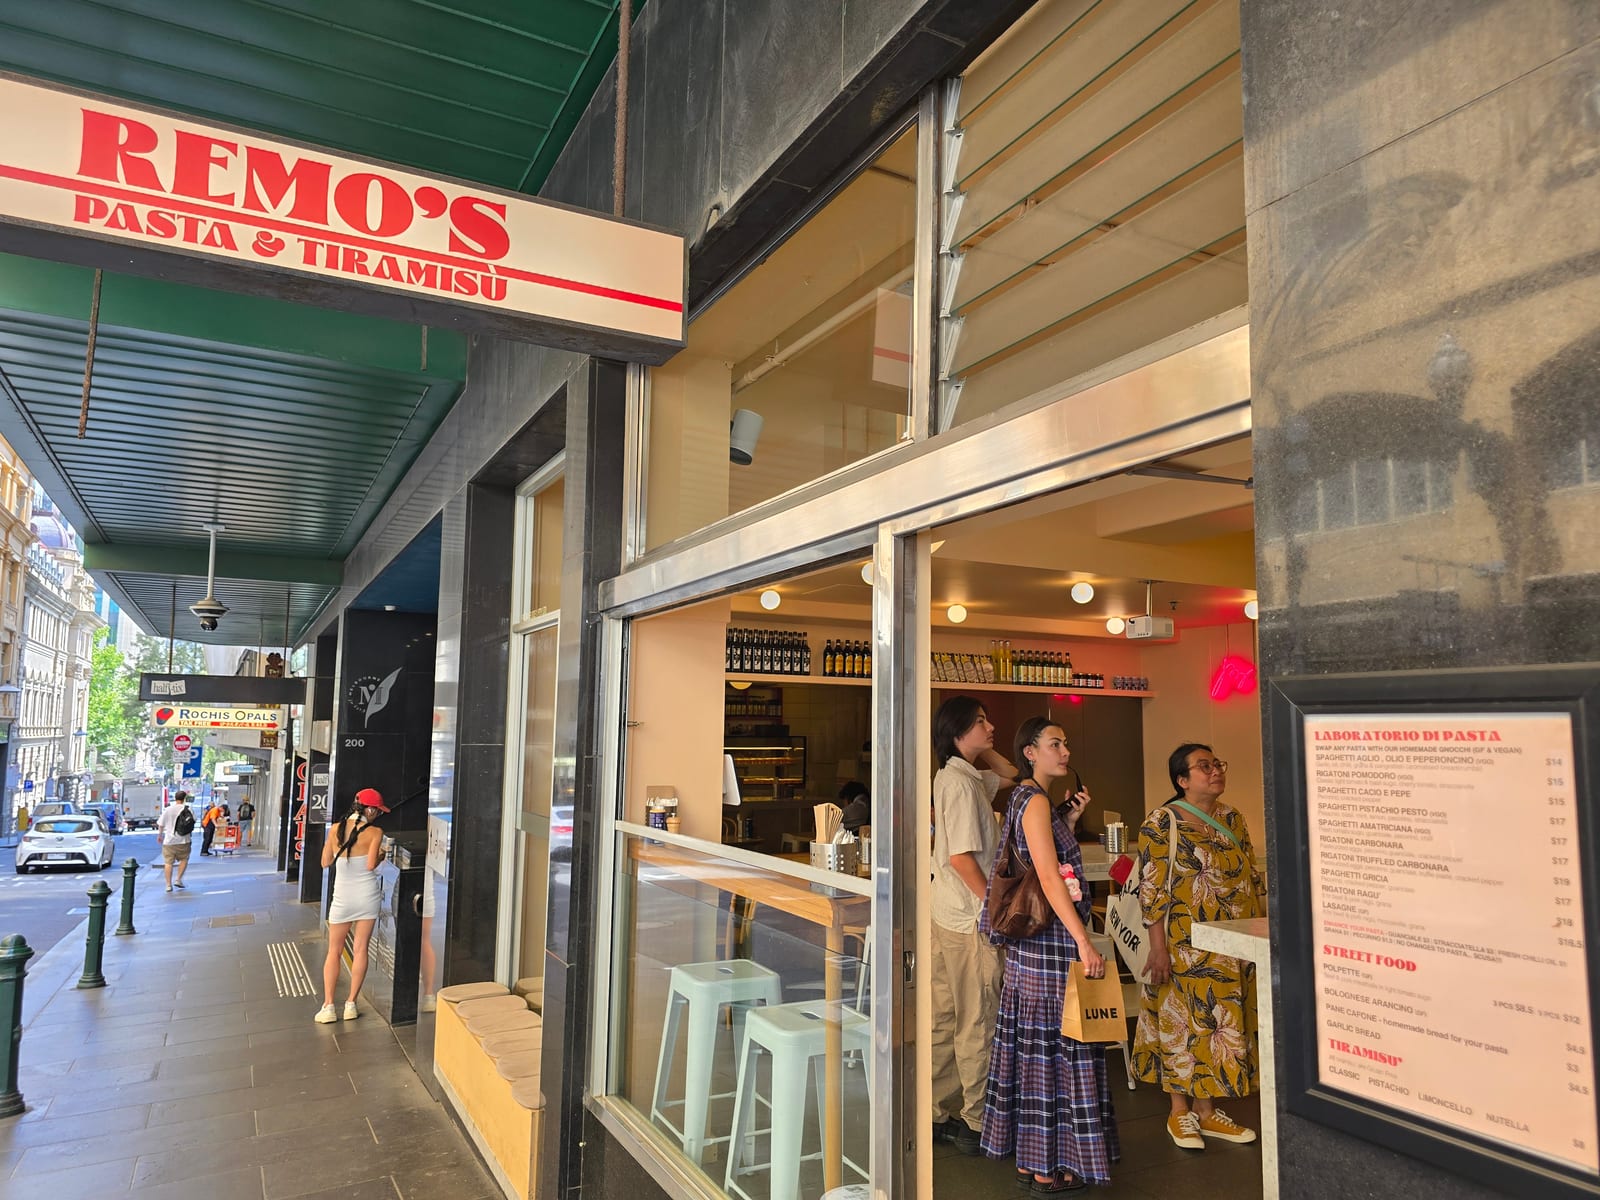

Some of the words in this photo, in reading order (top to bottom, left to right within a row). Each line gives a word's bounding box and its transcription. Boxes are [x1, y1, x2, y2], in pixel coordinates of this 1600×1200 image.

[77, 108, 510, 260] REMO'S
[73, 195, 240, 252] PASTA
[252, 231, 285, 257] &
[297, 238, 508, 302] TIRAMISÙ
[180, 709, 230, 720] ROCHIS
[235, 710, 277, 721] OPALS
[345, 739, 365, 747] 200
[1314, 731, 1420, 741] LABORATORIO
[1423, 731, 1440, 741] DI
[1443, 731, 1502, 742] PASTA
[1413, 756, 1474, 764] PEPERONCINO
[1546, 758, 1563, 766] $14
[1316, 770, 1350, 778] RIGATONI
[1352, 771, 1396, 780] POMODORO
[1547, 777, 1565, 786] $15
[1317, 786, 1357, 795] SPAGHETTI
[1358, 788, 1382, 796] CACIO
[1391, 790, 1412, 798] PEPE
[1318, 802, 1358, 812] SPAGHETTI
[1359, 805, 1400, 815] PISTACHIO
[1401, 808, 1429, 816] PESTO
[1549, 817, 1567, 826] $17
[1319, 819, 1358, 829] SPAGHETTI
[1360, 822, 1413, 833] AMATRICIANA
[1550, 837, 1568, 846] $17
[1320, 835, 1354, 845] RIGATONI
[1355, 838, 1404, 850] CARBONARA
[1552, 856, 1569, 866] $17
[1320, 851, 1355, 862] RIGATONI
[1357, 855, 1395, 866] TRUFFLED
[1396, 860, 1450, 873] CARBONARA
[1321, 868, 1361, 879] SPAGHETTI
[1362, 873, 1389, 883] GRICIA
[1554, 897, 1572, 906] $17
[1322, 885, 1356, 896] RIGATONI
[1323, 901, 1357, 913] LASAGNE
[1407, 941, 1436, 952] CHANGES
[1323, 944, 1374, 964] STREET
[1376, 954, 1417, 972] FOOD
[1324, 963, 1360, 977] POLPETTE
[1325, 987, 1370, 1004] BOLOGNESE
[1372, 998, 1414, 1014] ARANCINO
[1085, 1008, 1118, 1020] LUNE
[1326, 1003, 1345, 1015] PANE
[1346, 1008, 1377, 1023] CAFONE
[1383, 1017, 1425, 1034] homemade
[1426, 1027, 1449, 1040] bread
[1451, 1034, 1462, 1043] for
[1464, 1038, 1483, 1051] your
[1485, 1043, 1509, 1057] pasta
[1327, 1019, 1354, 1033] GARLIC
[1355, 1027, 1381, 1040] BREAD
[1329, 1065, 1361, 1082] CLASSIC
[1369, 1077, 1410, 1097] PISTACHIO
[1418, 1092, 1473, 1116] LIMONCELLO
[1486, 1112, 1531, 1134] NUTELLA
